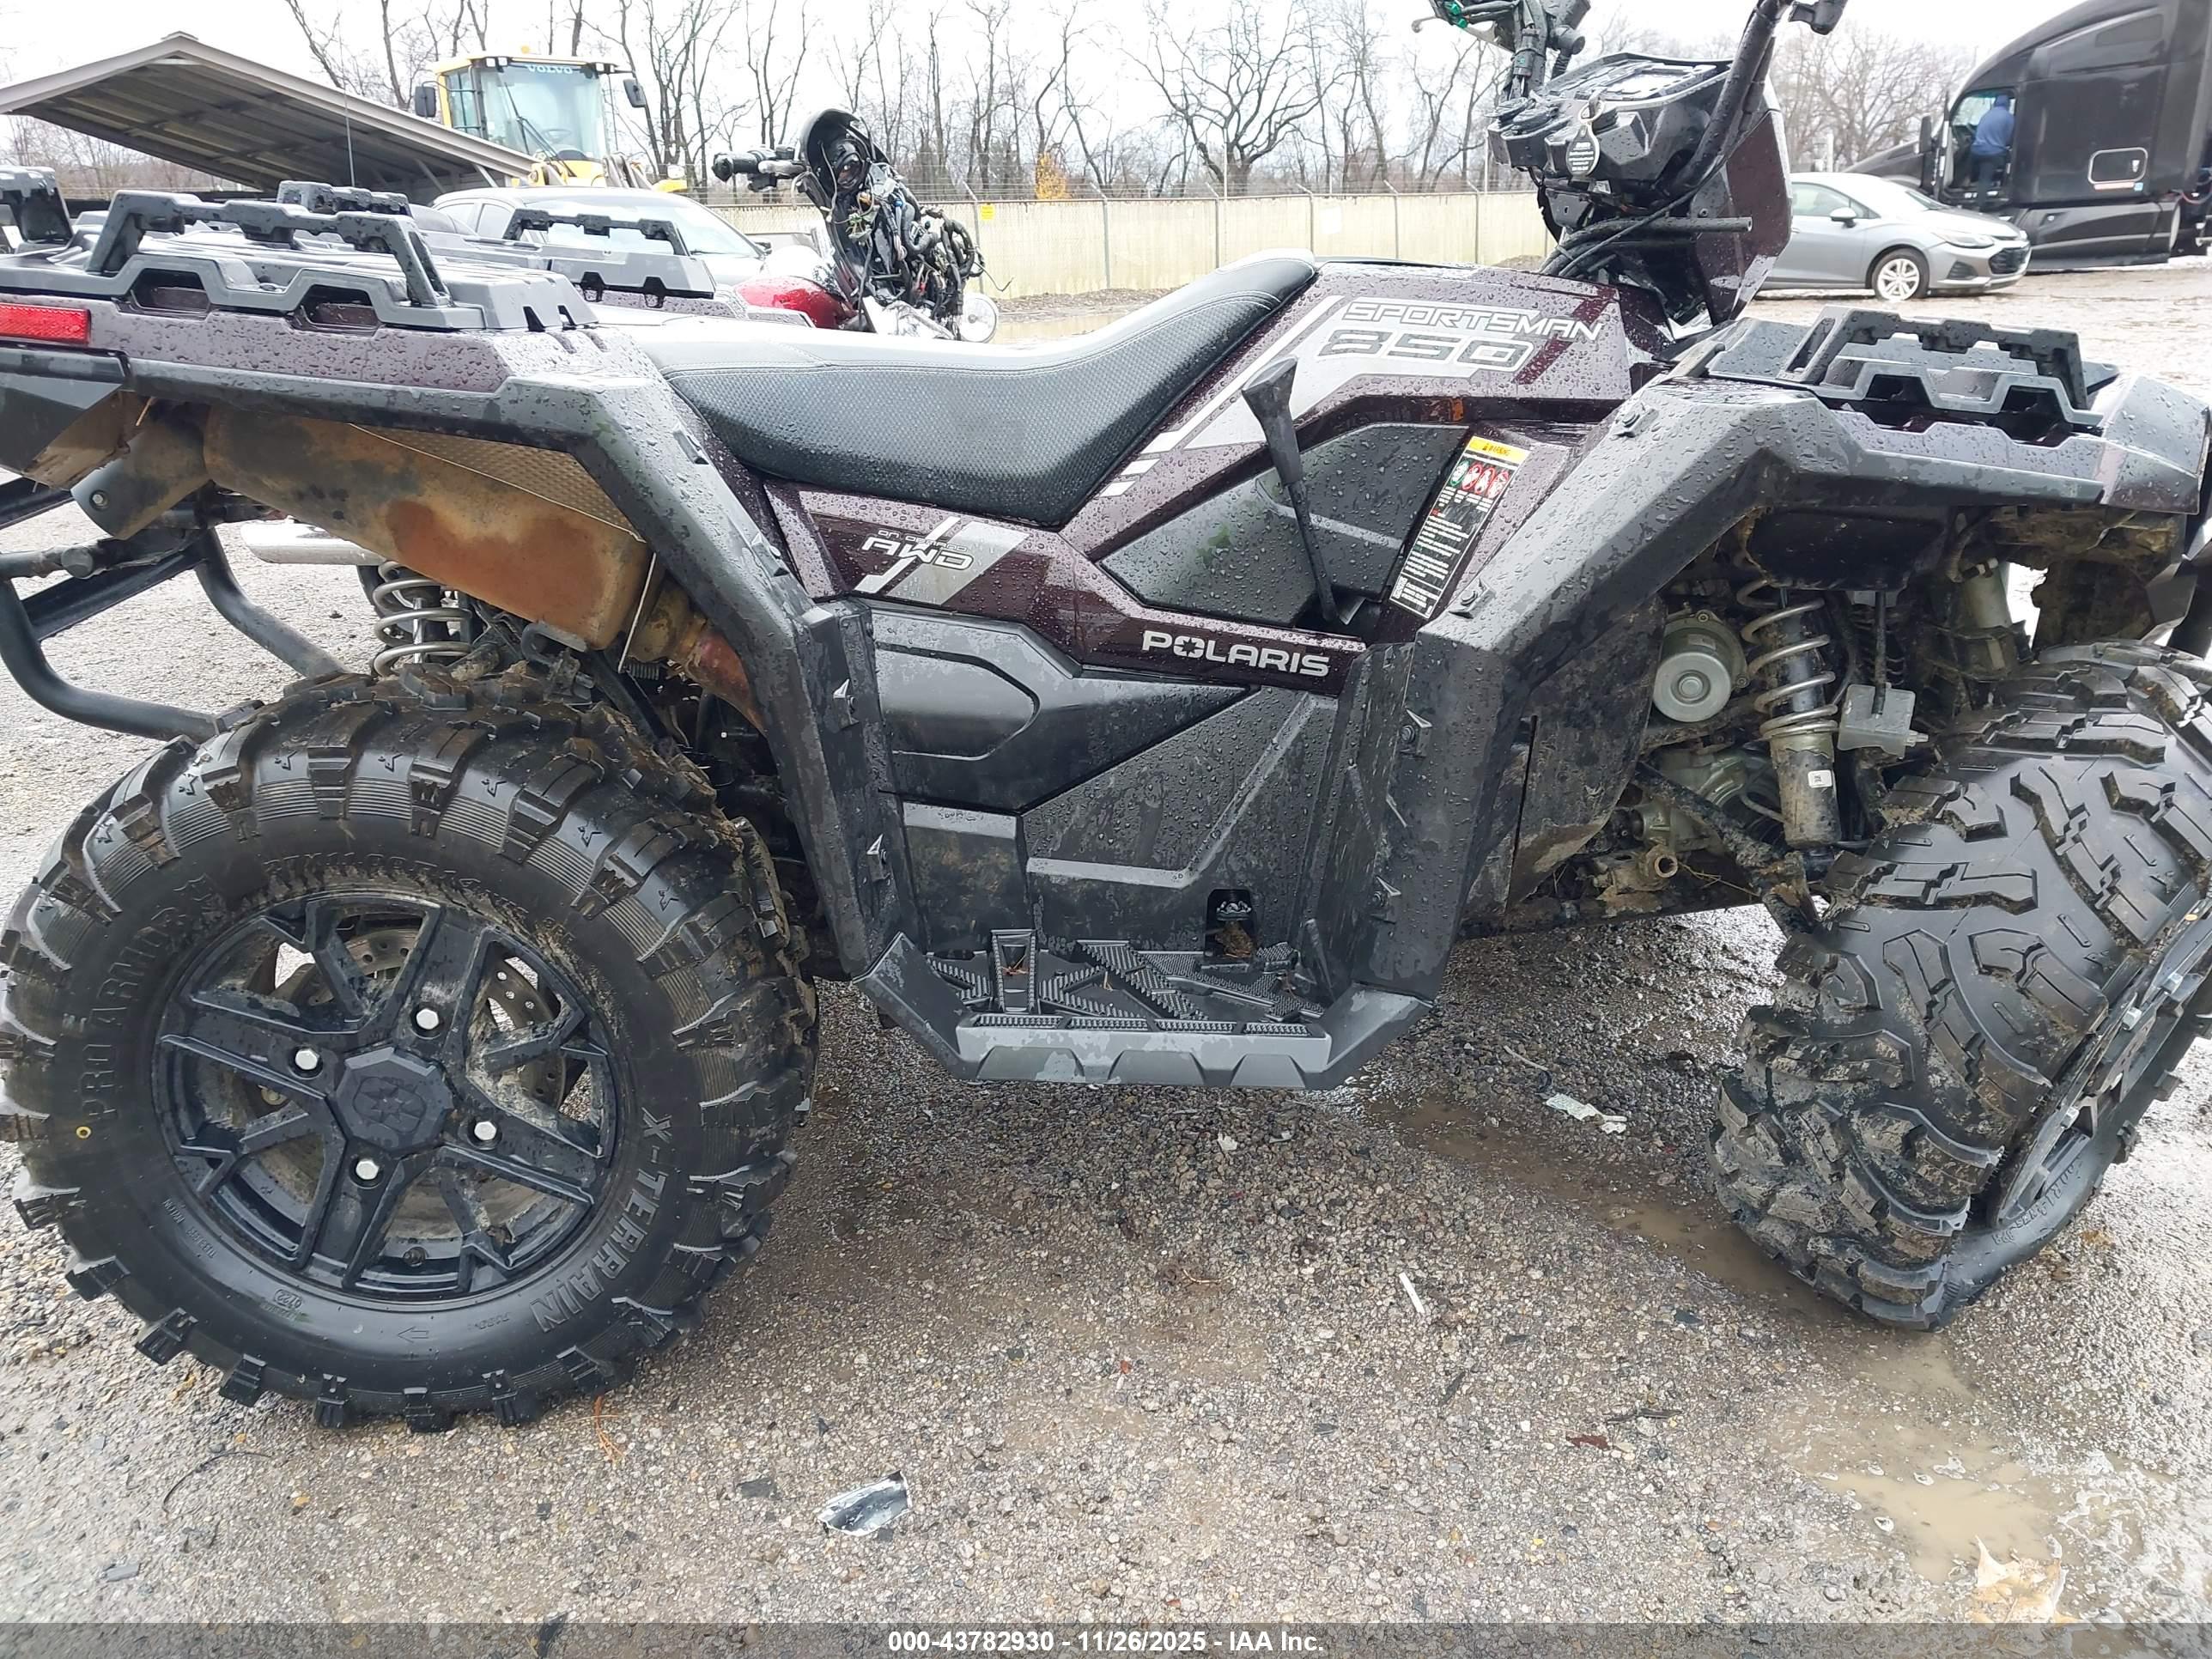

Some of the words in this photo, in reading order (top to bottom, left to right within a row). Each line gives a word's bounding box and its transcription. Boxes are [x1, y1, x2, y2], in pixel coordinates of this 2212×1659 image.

[1341, 301, 1603, 341] SPORTSMAN
[1316, 328, 1534, 371] 850
[860, 536, 975, 571] AWD
[1141, 629, 1330, 678] POLARIS
[528, 1106, 673, 1333] X-TERRAIN
